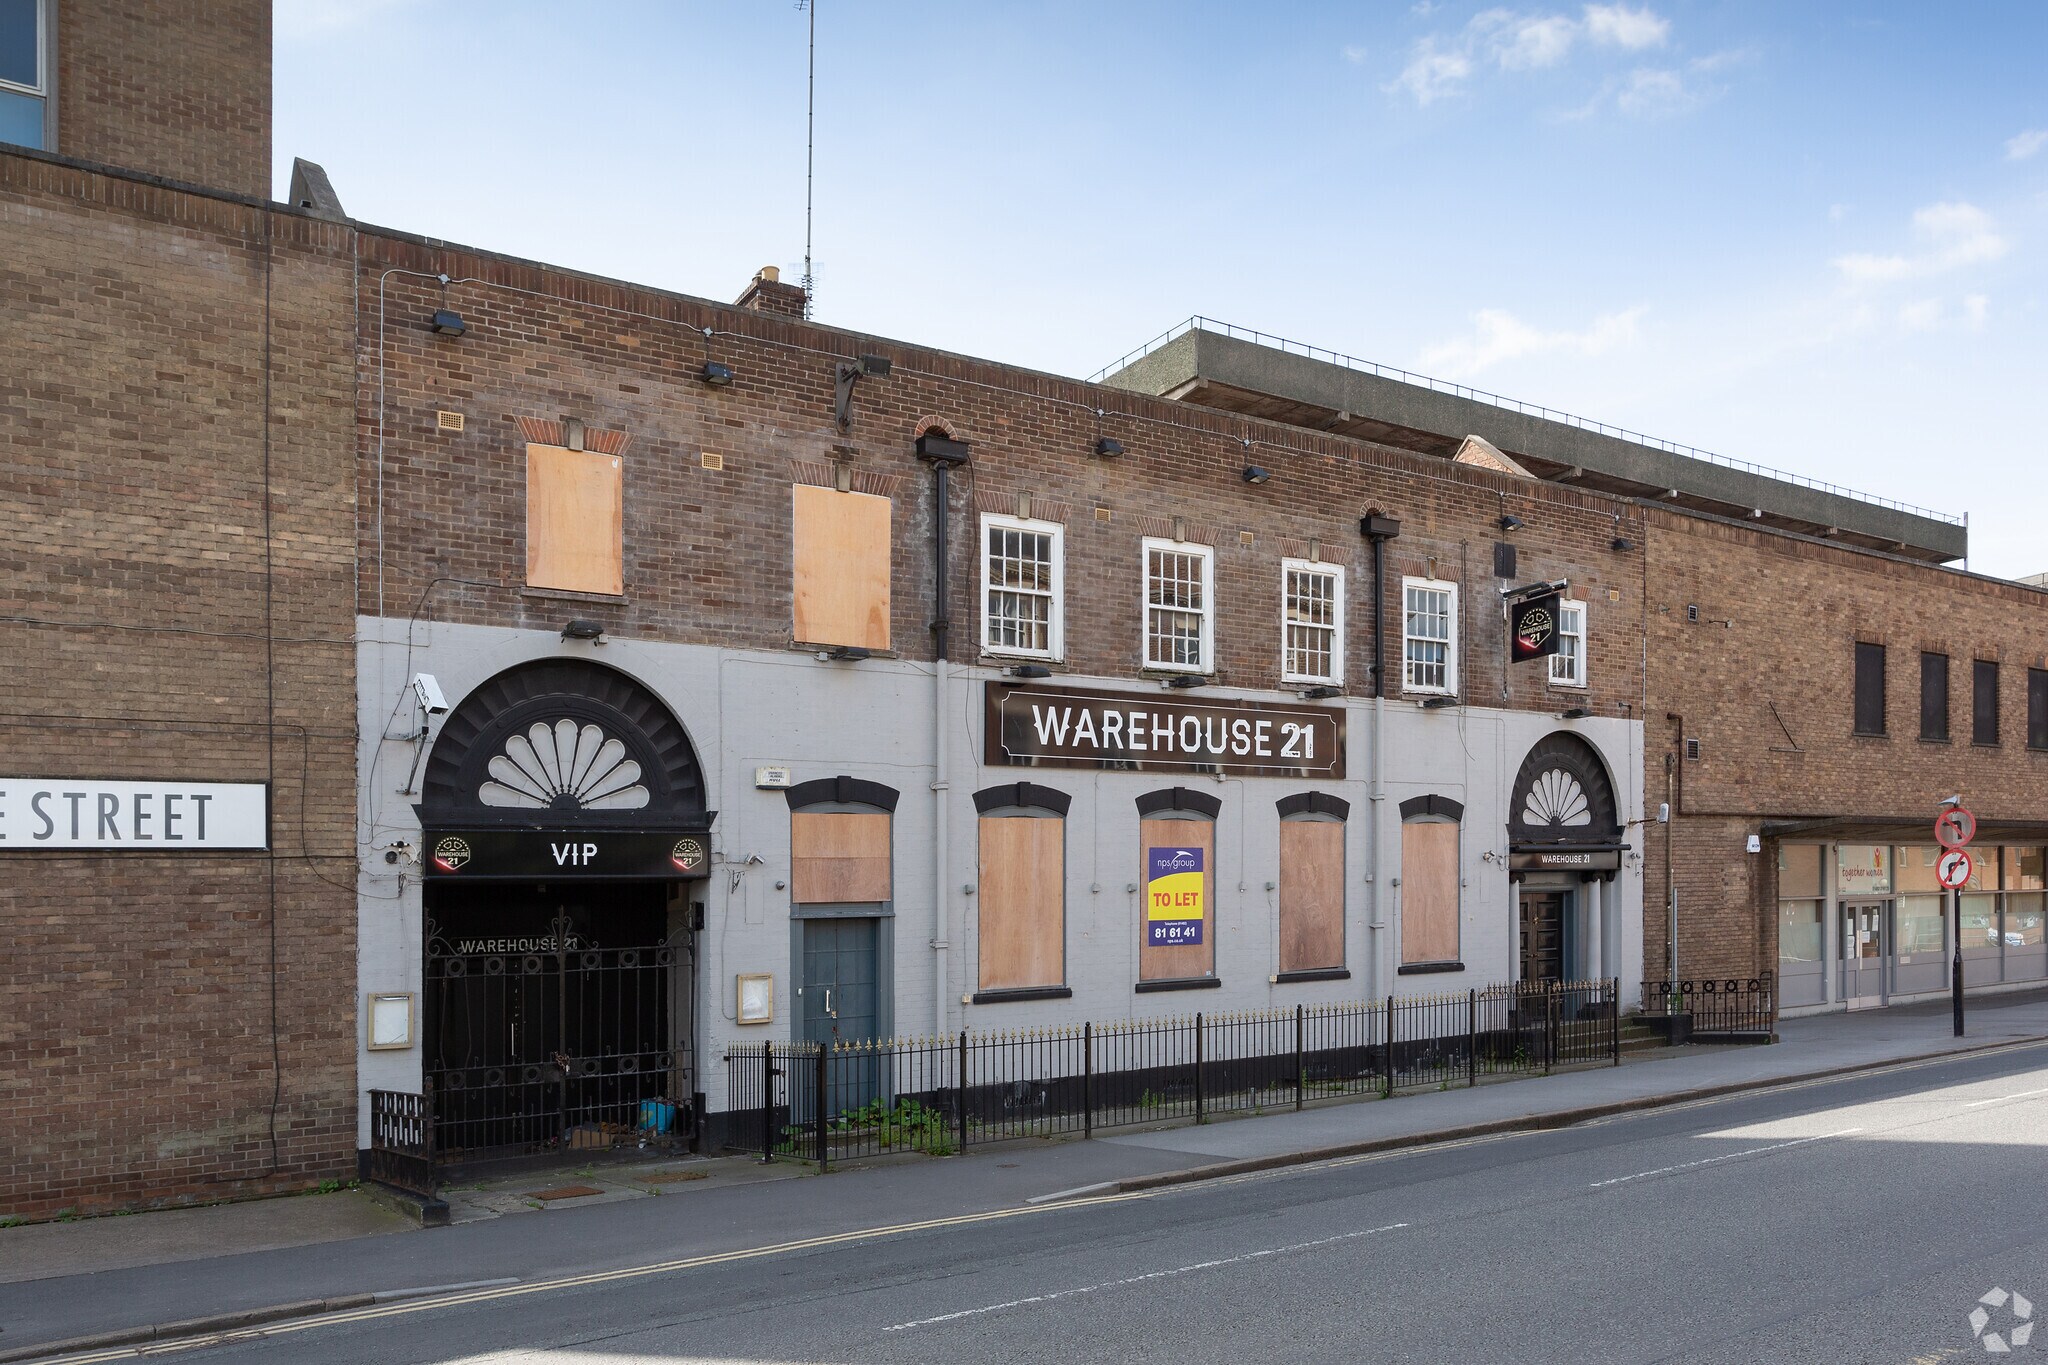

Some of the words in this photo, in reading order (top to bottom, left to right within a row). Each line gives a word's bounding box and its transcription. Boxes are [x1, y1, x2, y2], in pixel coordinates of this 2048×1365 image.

[1520, 622, 1551, 636] WAREHOUSE
[1530, 632, 1540, 643] 21
[1032, 704, 1272, 757] WAREHOUSE
[1280, 723, 1314, 760] 21
[31, 791, 213, 841] STREET
[447, 857, 459, 865] 21
[550, 843, 598, 866] VIP
[683, 857, 692, 865] 21
[1541, 854, 1582, 863] WAREHOUSE
[1583, 854, 1590, 863] 21
[1842, 865, 1865, 882] together
[1153, 892, 1171, 907] TO
[1175, 892, 1199, 907] LET
[1155, 928, 1167, 938] 81
[1169, 927, 1181, 938] 61
[1183, 926, 1196, 937] 41
[460, 937, 559, 954] WAREHOUSE
[562, 937, 578, 950] 21
